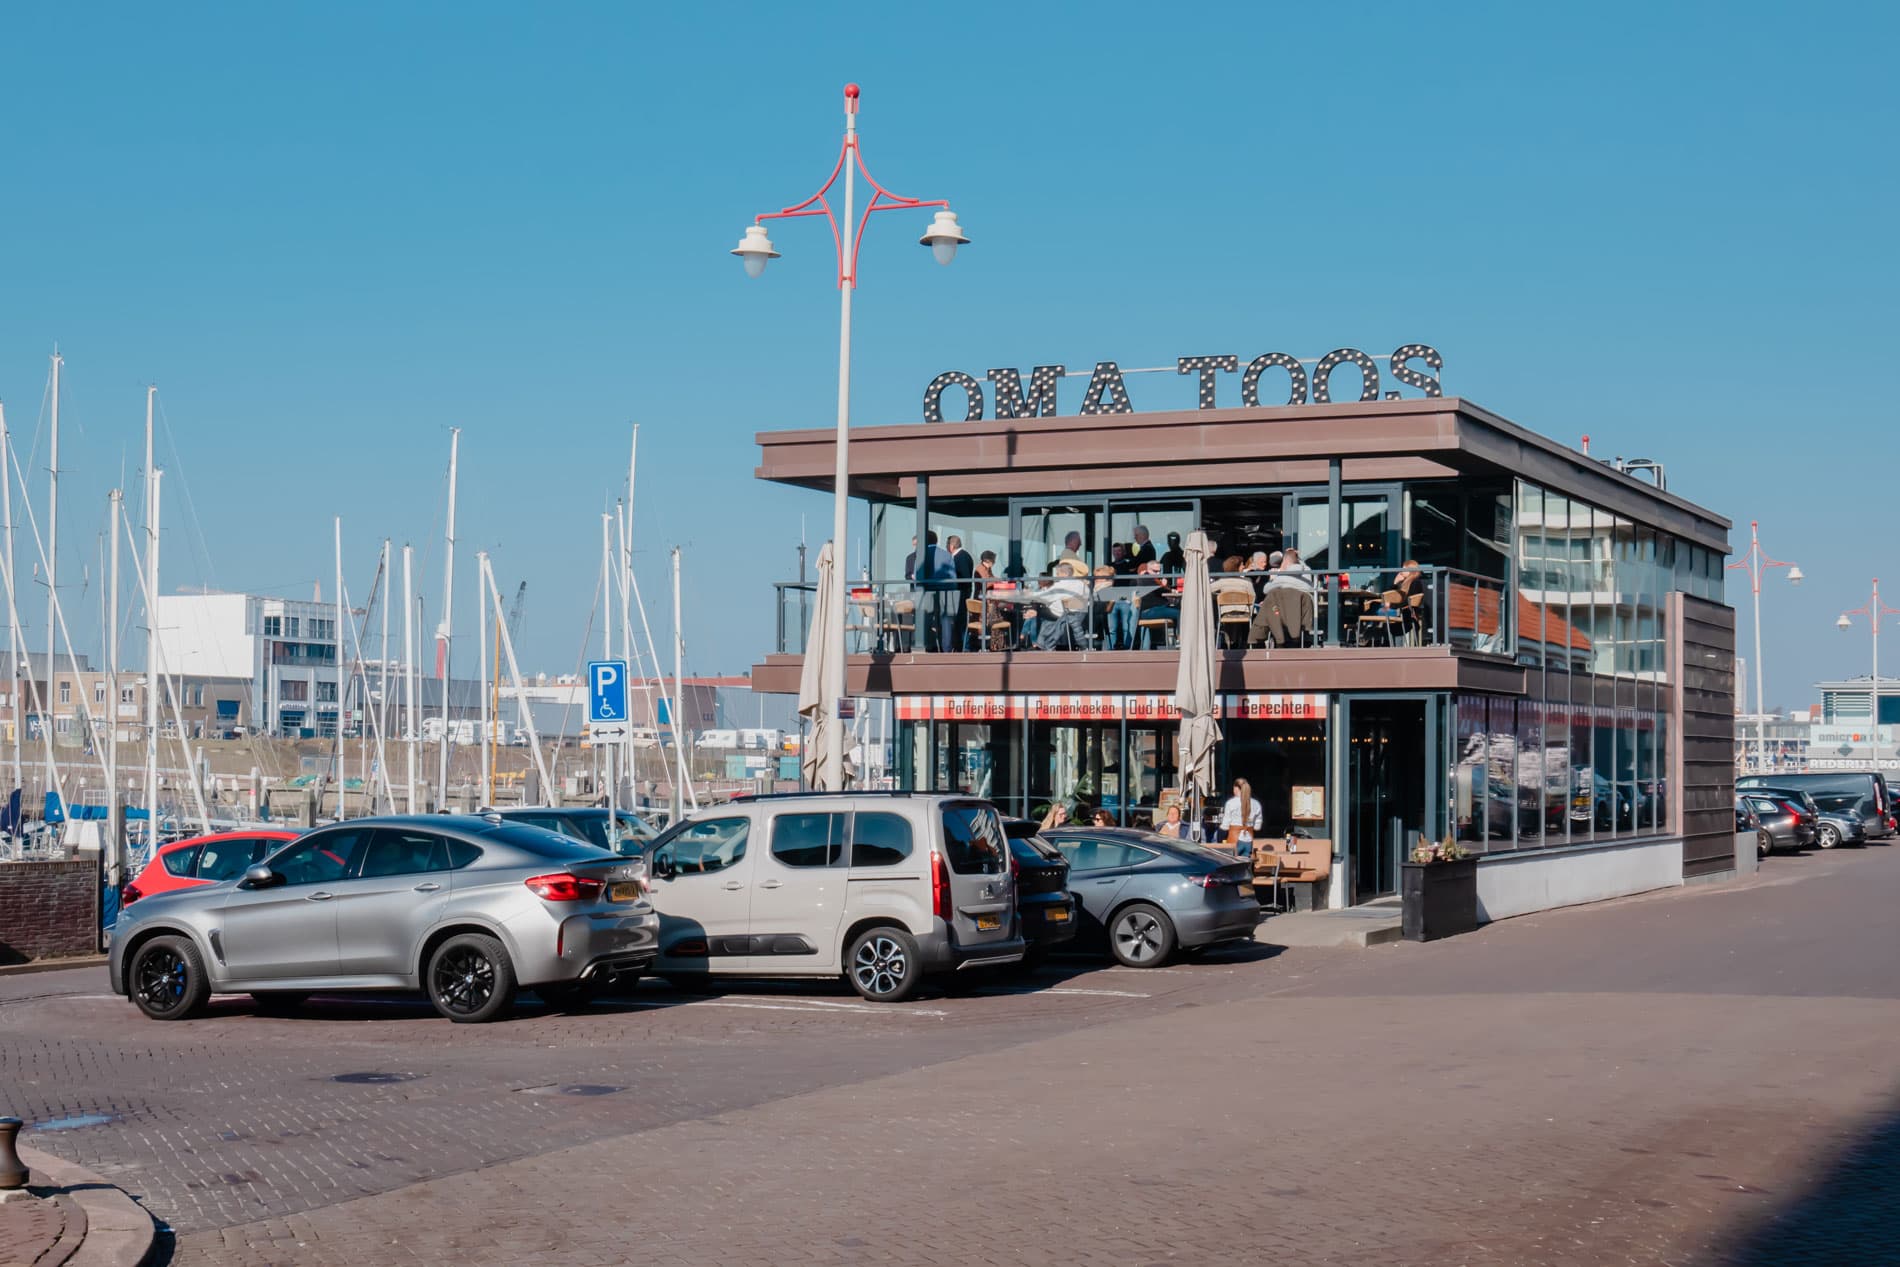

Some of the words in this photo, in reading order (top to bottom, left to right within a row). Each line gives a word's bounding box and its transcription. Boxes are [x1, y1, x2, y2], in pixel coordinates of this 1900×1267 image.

[924, 362, 1134, 424] OMA
[1178, 344, 1443, 409] TOOS
[597, 666, 617, 696] P
[949, 700, 1005, 717] Poffertjes
[1036, 699, 1115, 714] Pannenkoeken
[1129, 699, 1152, 714] Oud
[1241, 697, 1311, 714] Gerechten
